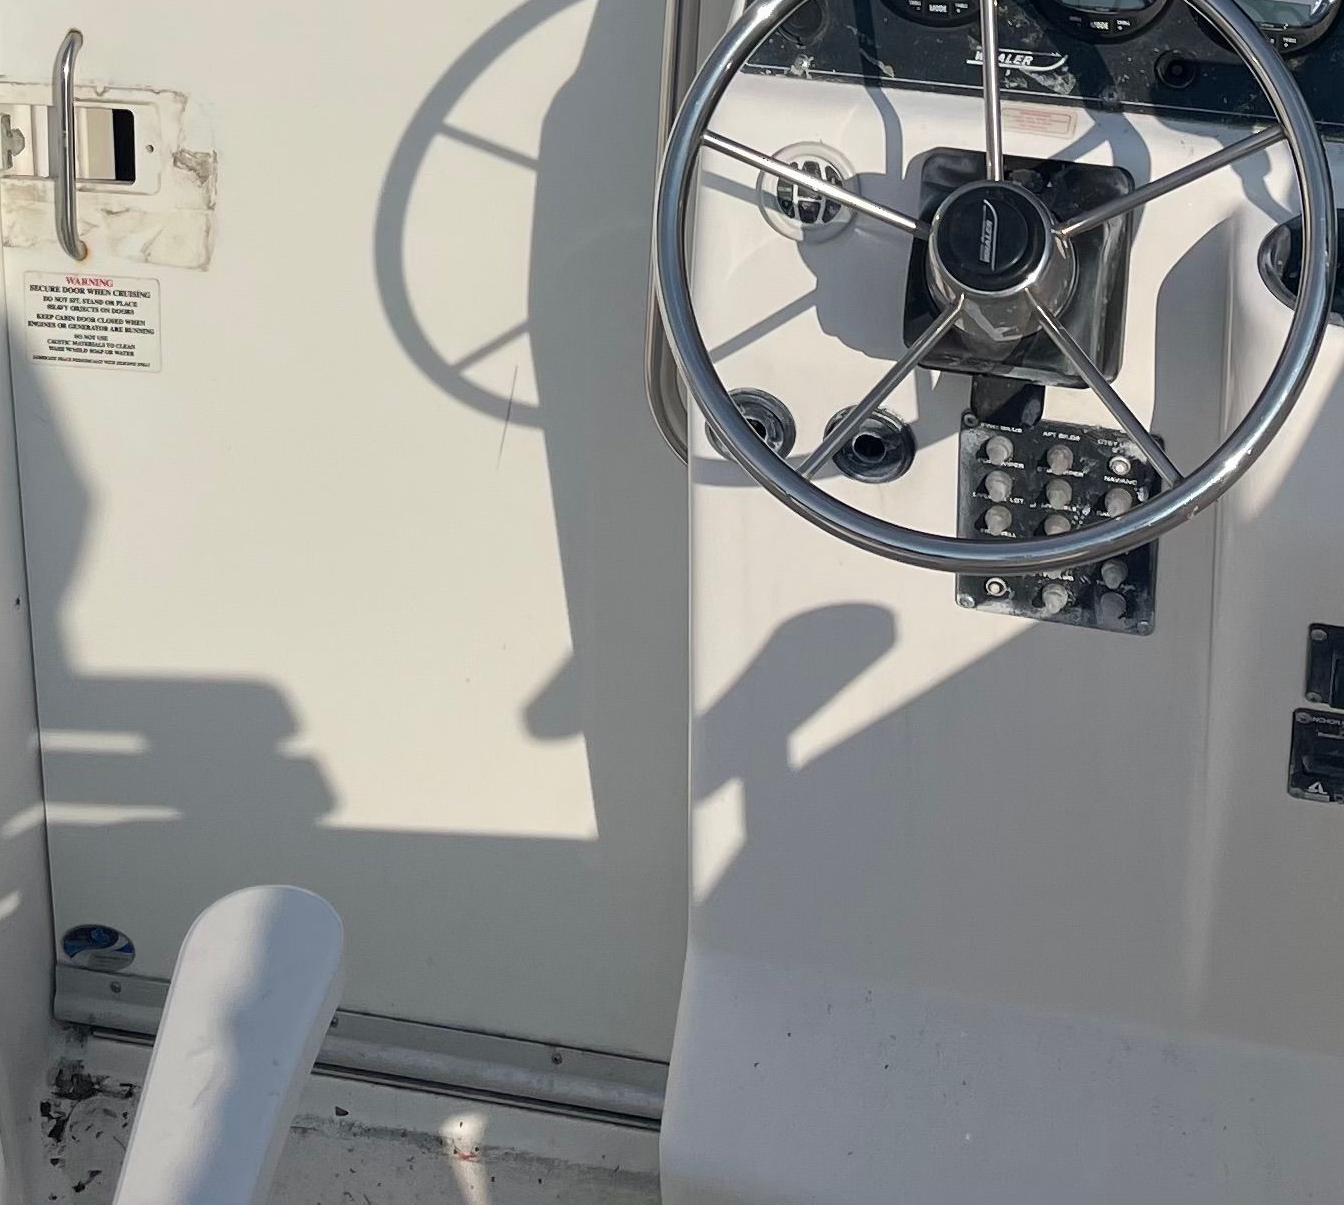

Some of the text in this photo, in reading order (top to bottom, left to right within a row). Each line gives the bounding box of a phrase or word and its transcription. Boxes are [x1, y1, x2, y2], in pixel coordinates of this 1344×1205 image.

[975, 51, 1033, 66] WALER
[65, 277, 113, 287] WARNING
[62, 287, 85, 295] DOOR
[113, 290, 151, 298] CRUISING
[68, 323, 108, 331] GENERATOR
[125, 327, 155, 335] RUNNING
[1312, 716, 1341, 726] NCHOR
